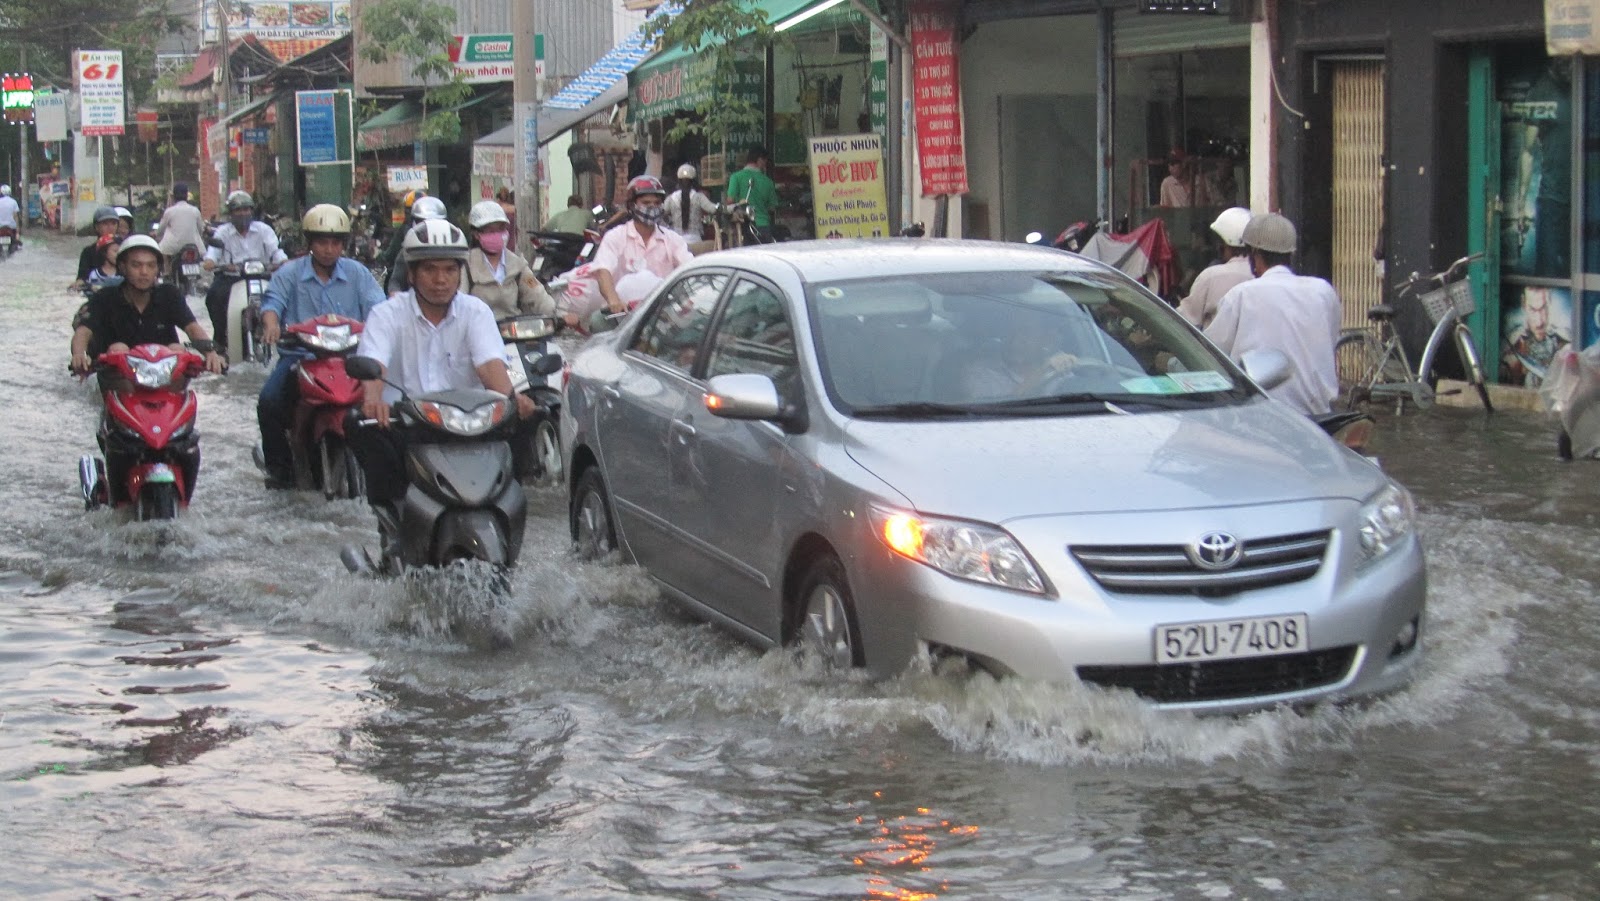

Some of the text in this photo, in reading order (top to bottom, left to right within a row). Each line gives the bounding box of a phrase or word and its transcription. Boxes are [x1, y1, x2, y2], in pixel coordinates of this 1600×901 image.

[483, 43, 508, 52] Castrol
[83, 63, 119, 80] 61
[818, 157, 879, 184] ĐỨC HUY
[1165, 619, 1298, 658] 52U-7408
